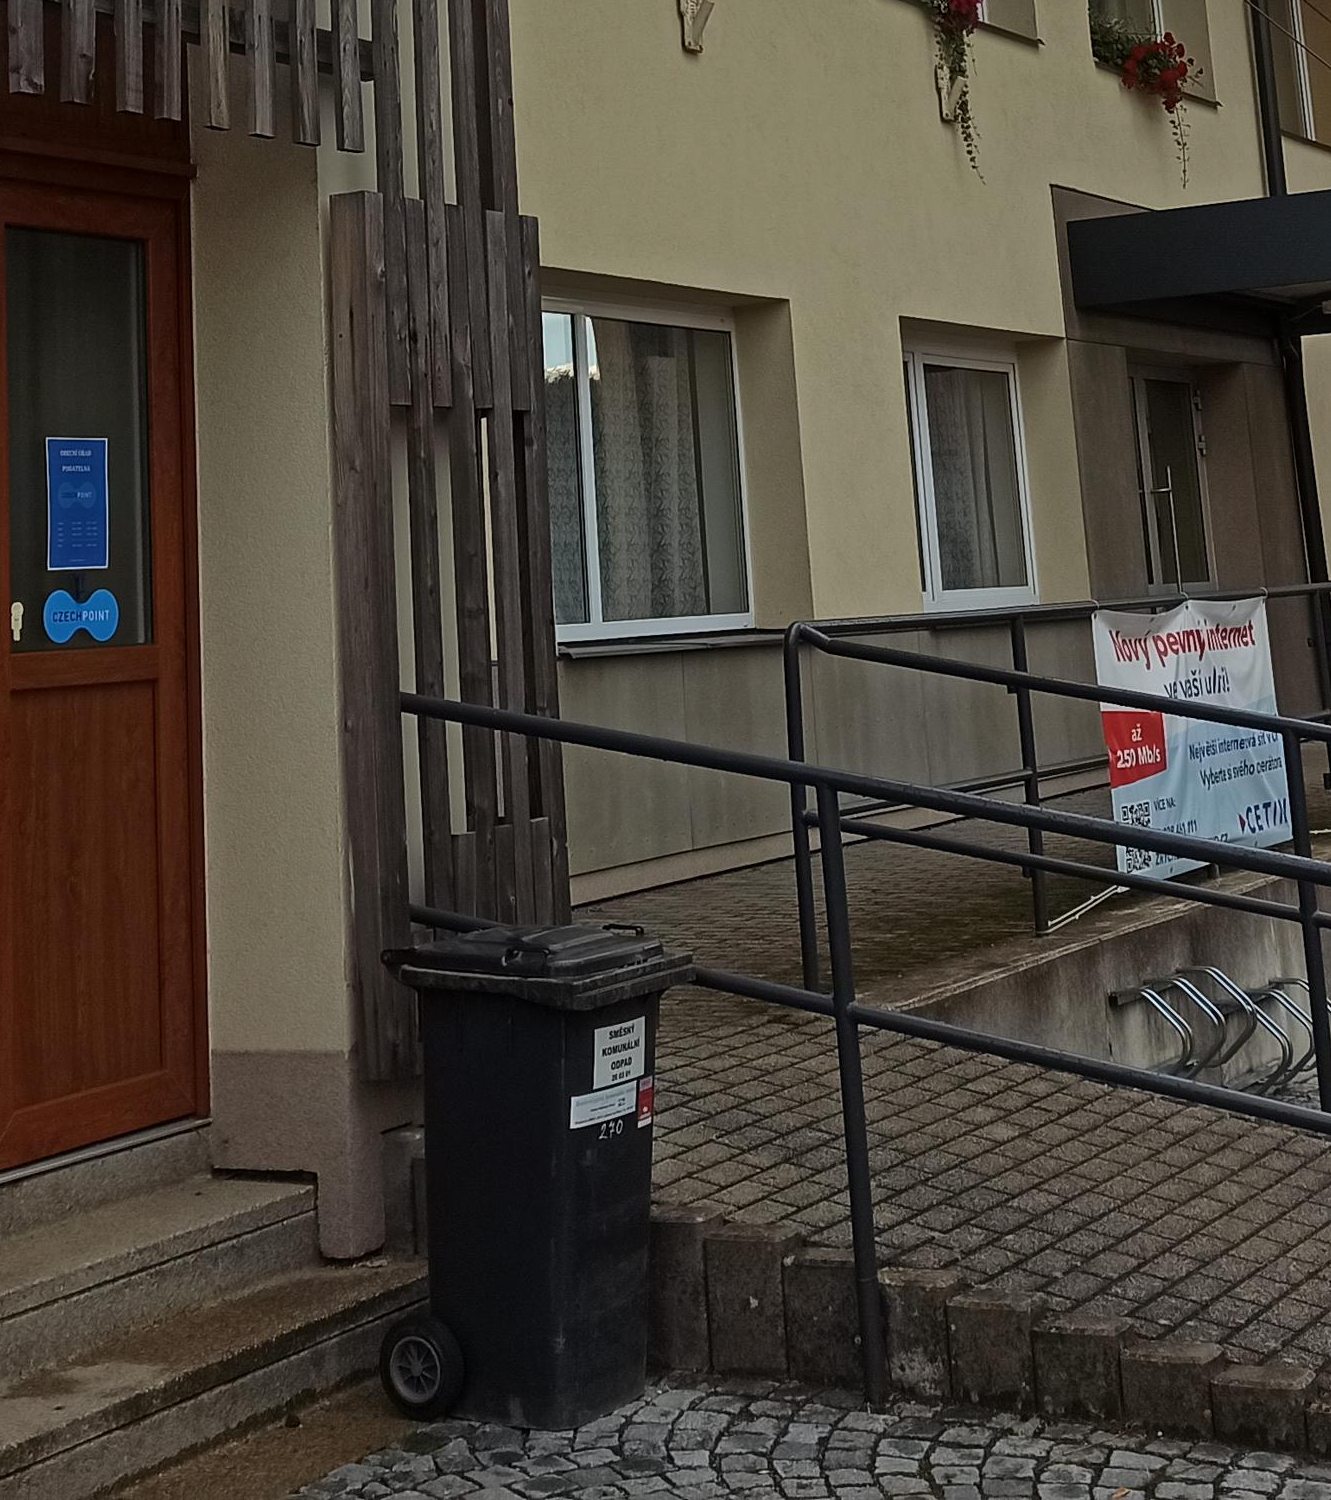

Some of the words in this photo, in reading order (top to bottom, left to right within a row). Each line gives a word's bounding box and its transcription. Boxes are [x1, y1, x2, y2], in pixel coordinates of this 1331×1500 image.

[1109, 630, 1151, 670] Nový
[1152, 620, 1206, 667] pevný
[1206, 619, 1256, 651] internet
[1179, 669, 1204, 699] vaší
[1131, 724, 1143, 742] až
[1116, 750, 1136, 769] 250
[1137, 746, 1161, 765] Mb/s
[1233, 759, 1255, 779] svého
[1154, 799, 1166, 812] VÍCE
[611, 1056, 633, 1070] ODPAD
